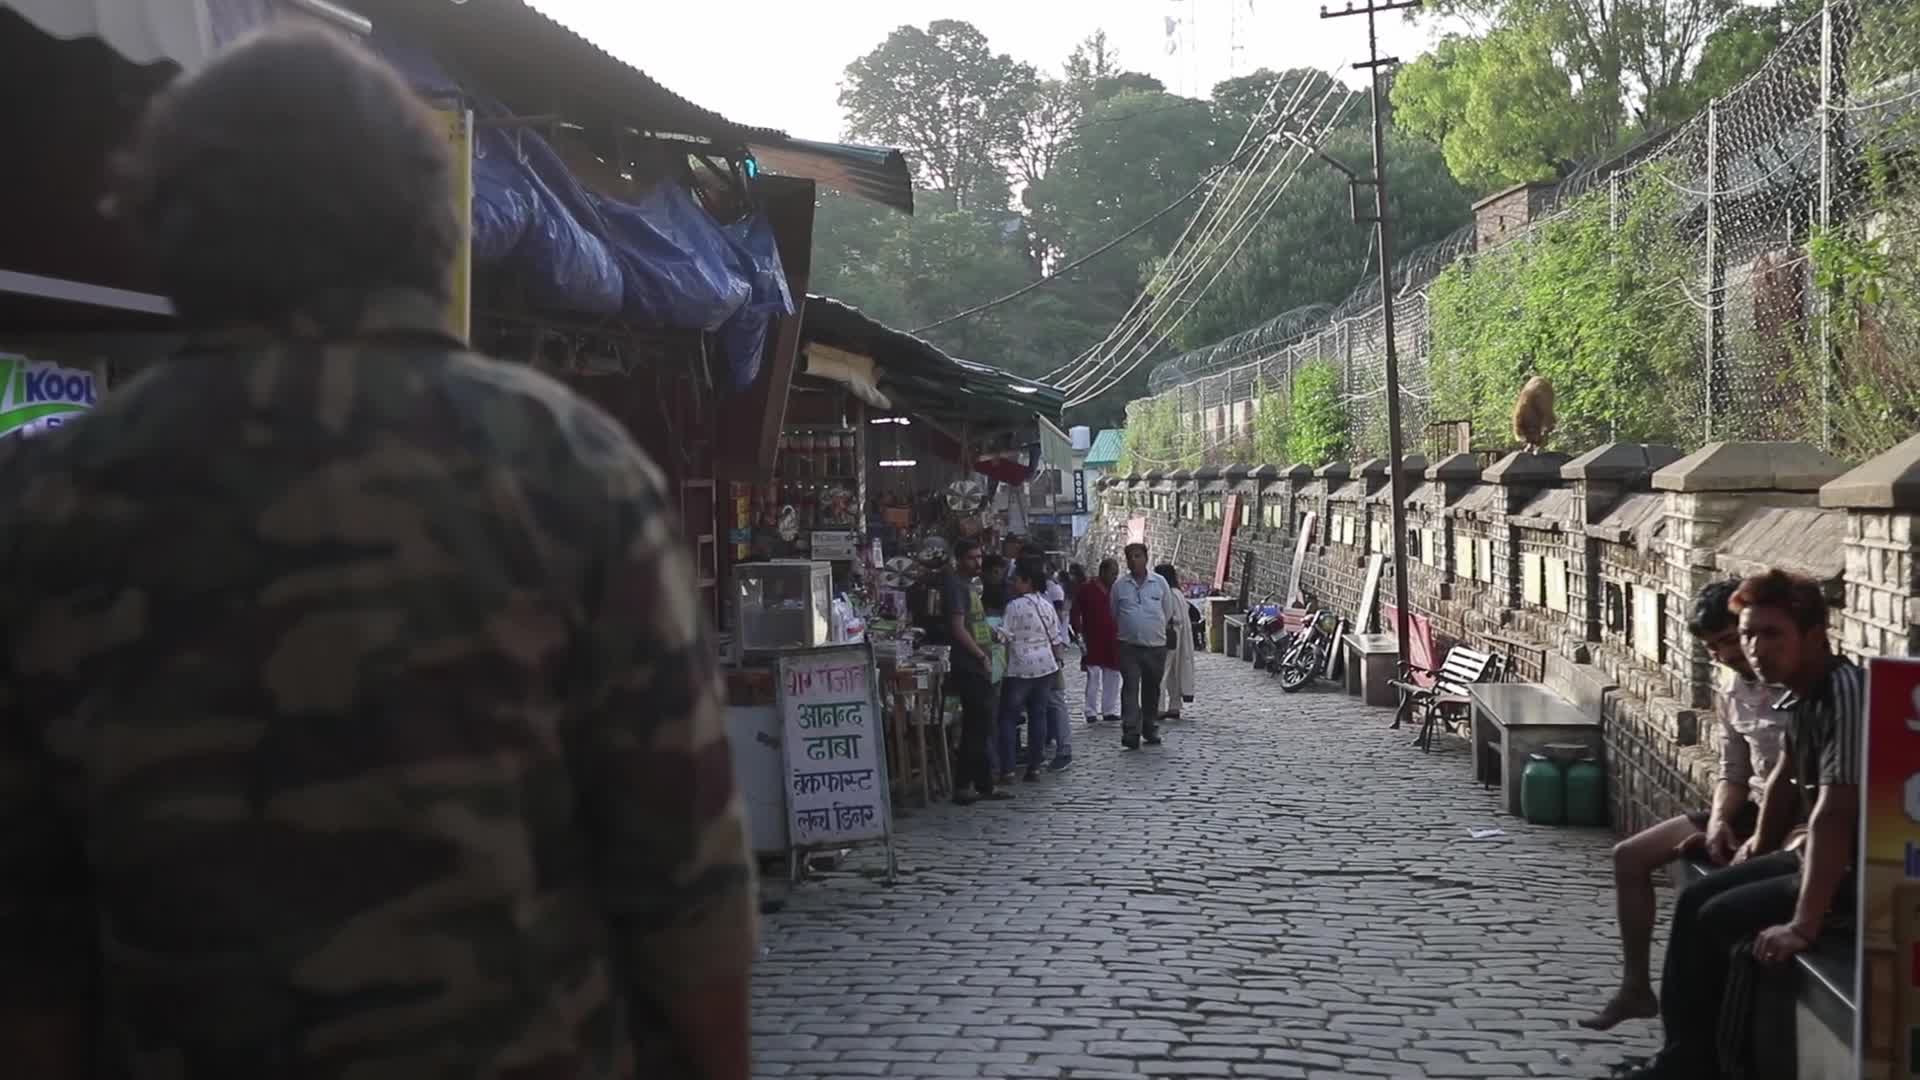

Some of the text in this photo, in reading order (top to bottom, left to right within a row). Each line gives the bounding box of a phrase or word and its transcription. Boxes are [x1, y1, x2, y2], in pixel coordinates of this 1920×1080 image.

[26, 367, 96, 404] KOOL
[1075, 472, 1083, 509] ROOMS
[798, 701, 867, 729] आनन्द
[803, 734, 862, 760] ढाबा
